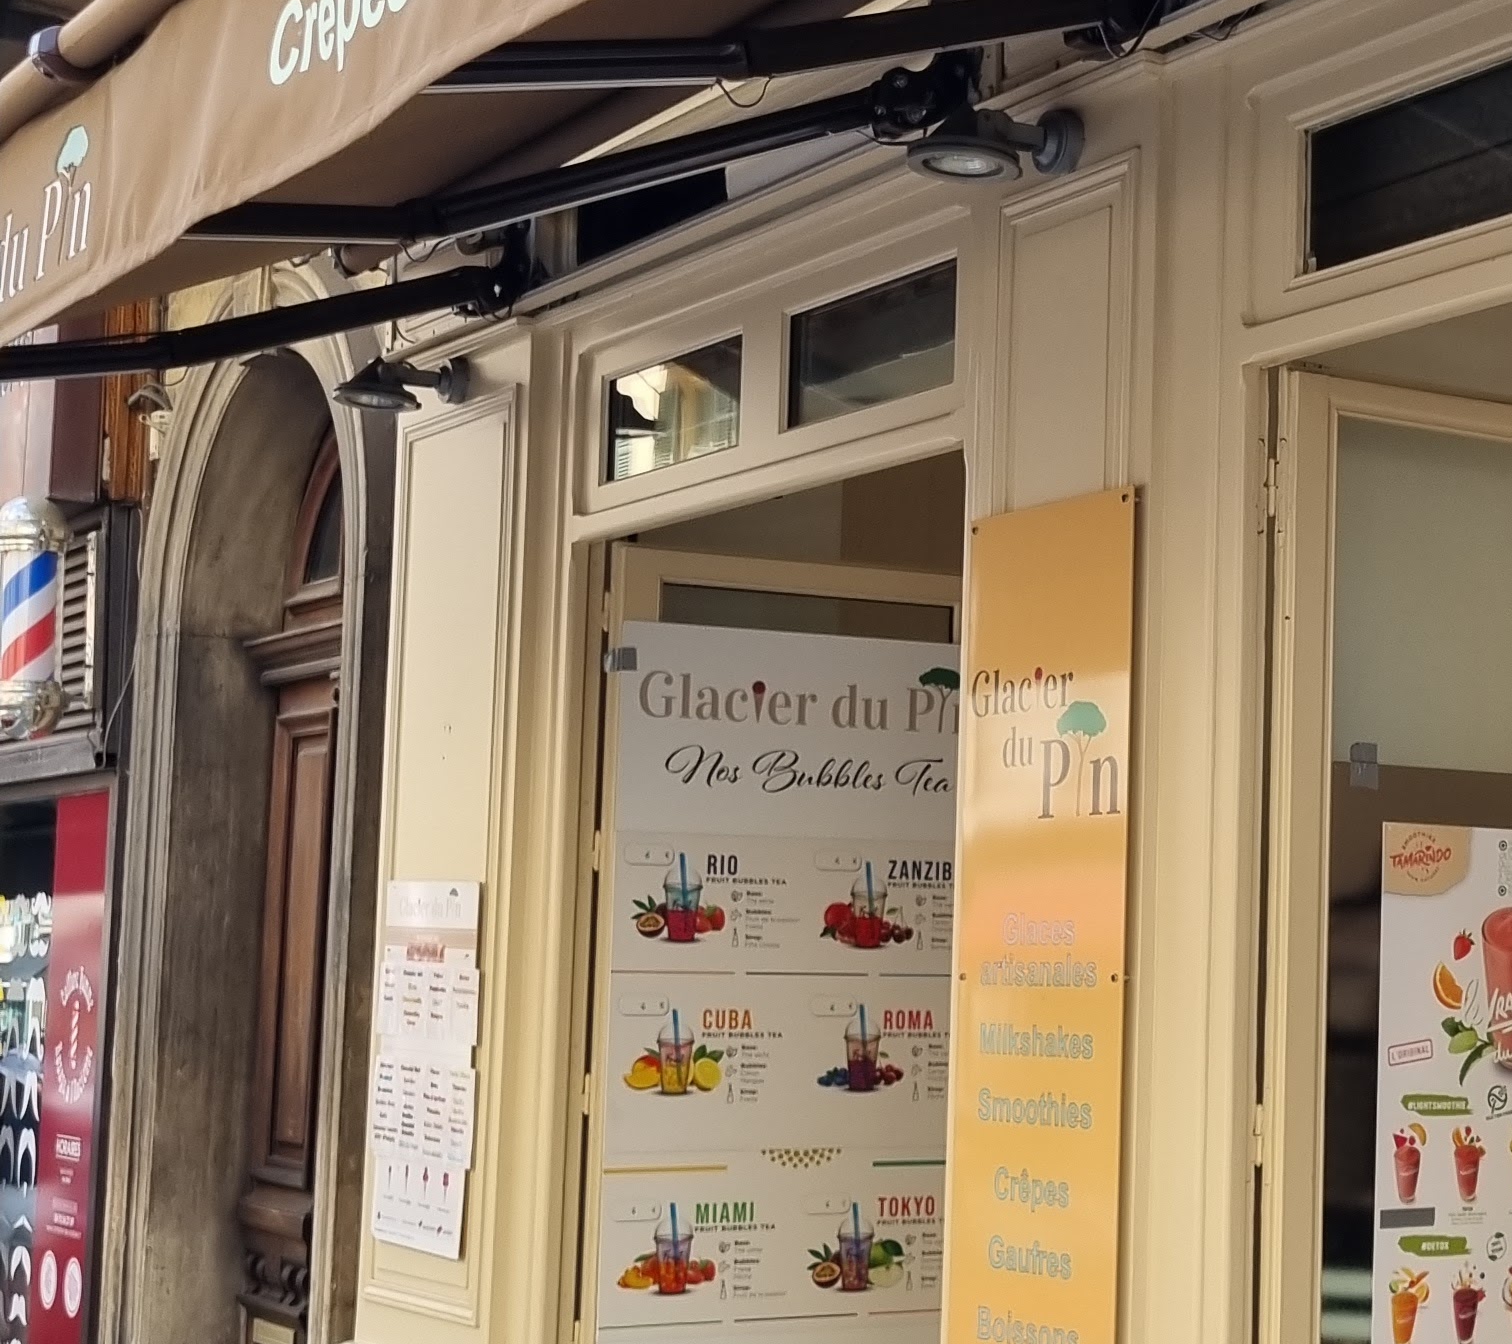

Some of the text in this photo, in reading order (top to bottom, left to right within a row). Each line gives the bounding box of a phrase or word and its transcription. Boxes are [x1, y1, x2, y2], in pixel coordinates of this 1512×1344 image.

[639, 670, 818, 726] Glacier
[831, 685, 890, 732] du
[972, 667, 1074, 718] Glacier
[1002, 726, 1033, 769] du
[1038, 701, 1121, 820] Pin
[665, 744, 953, 797] Nos Bubbles Tea
[707, 854, 738, 875] RIO
[732, 877, 769, 885] BUBBLES
[888, 859, 953, 881] ZANZIB
[1003, 912, 1075, 946] Glaces
[980, 953, 1097, 988] artisanales
[702, 1009, 752, 1030] CUBA
[883, 1010, 934, 1030] ROMA
[979, 1022, 1094, 1060] Milkshakes
[978, 1087, 1092, 1130] Smoothies
[878, 1196, 935, 1217] TOKYO
[994, 1166, 1070, 1213] Crêpes
[695, 1201, 755, 1224] MIAMI
[988, 1234, 1072, 1280] Gaufres
